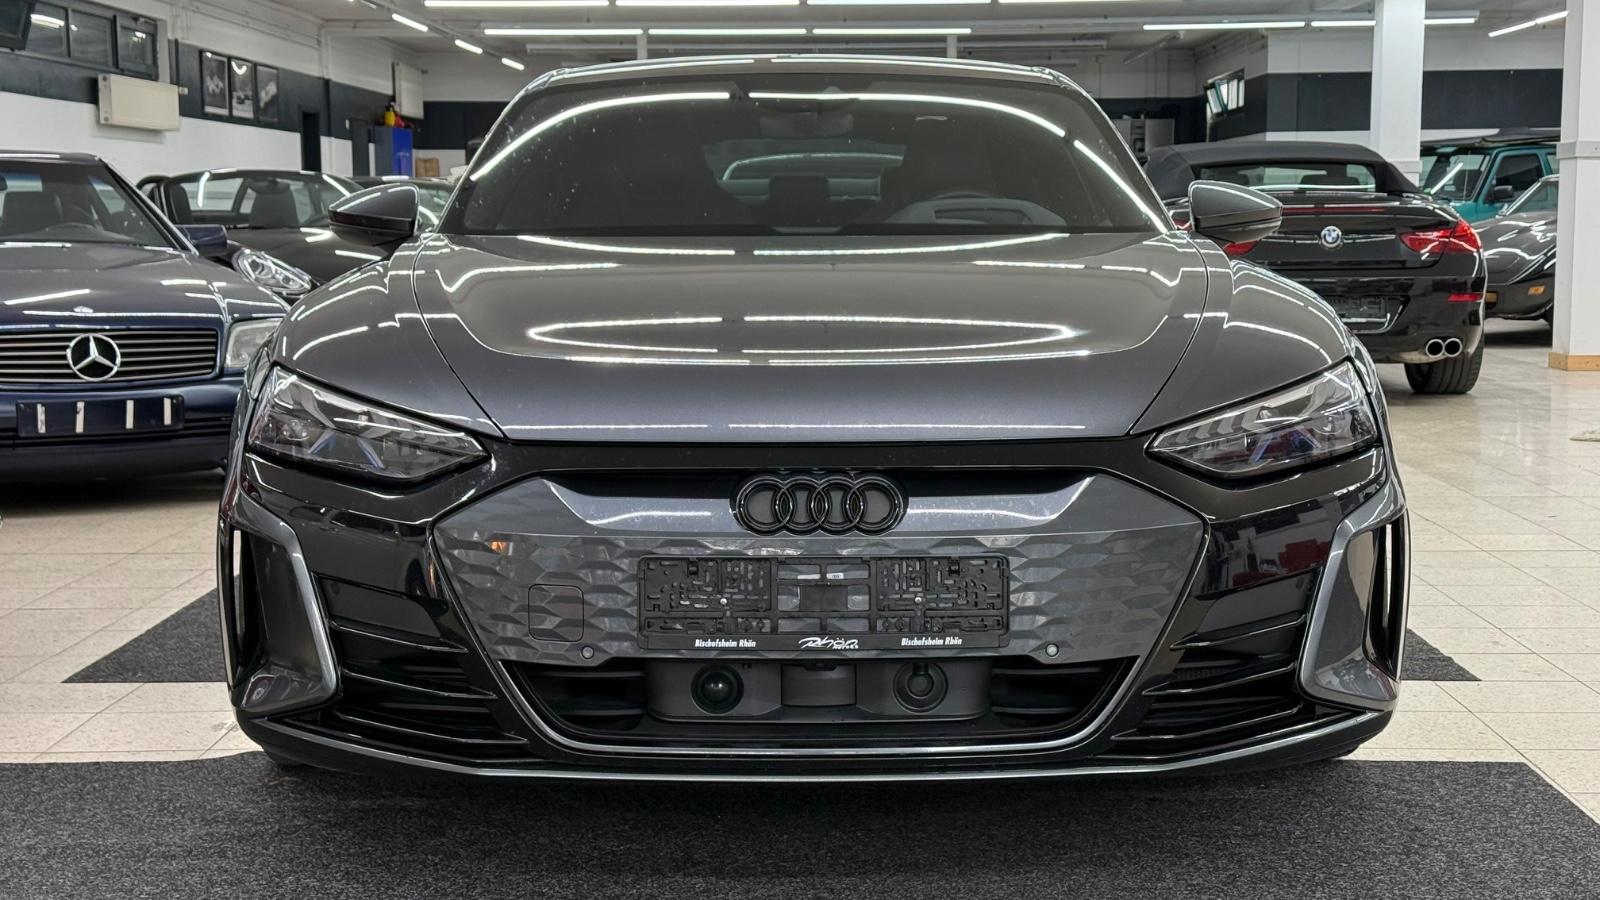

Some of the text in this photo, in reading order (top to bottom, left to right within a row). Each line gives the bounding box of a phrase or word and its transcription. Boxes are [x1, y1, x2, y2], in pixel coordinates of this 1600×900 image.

[695, 638, 756, 648] Bischofsheim Rhön
[901, 636, 963, 646] Bischofsheim Rhön
